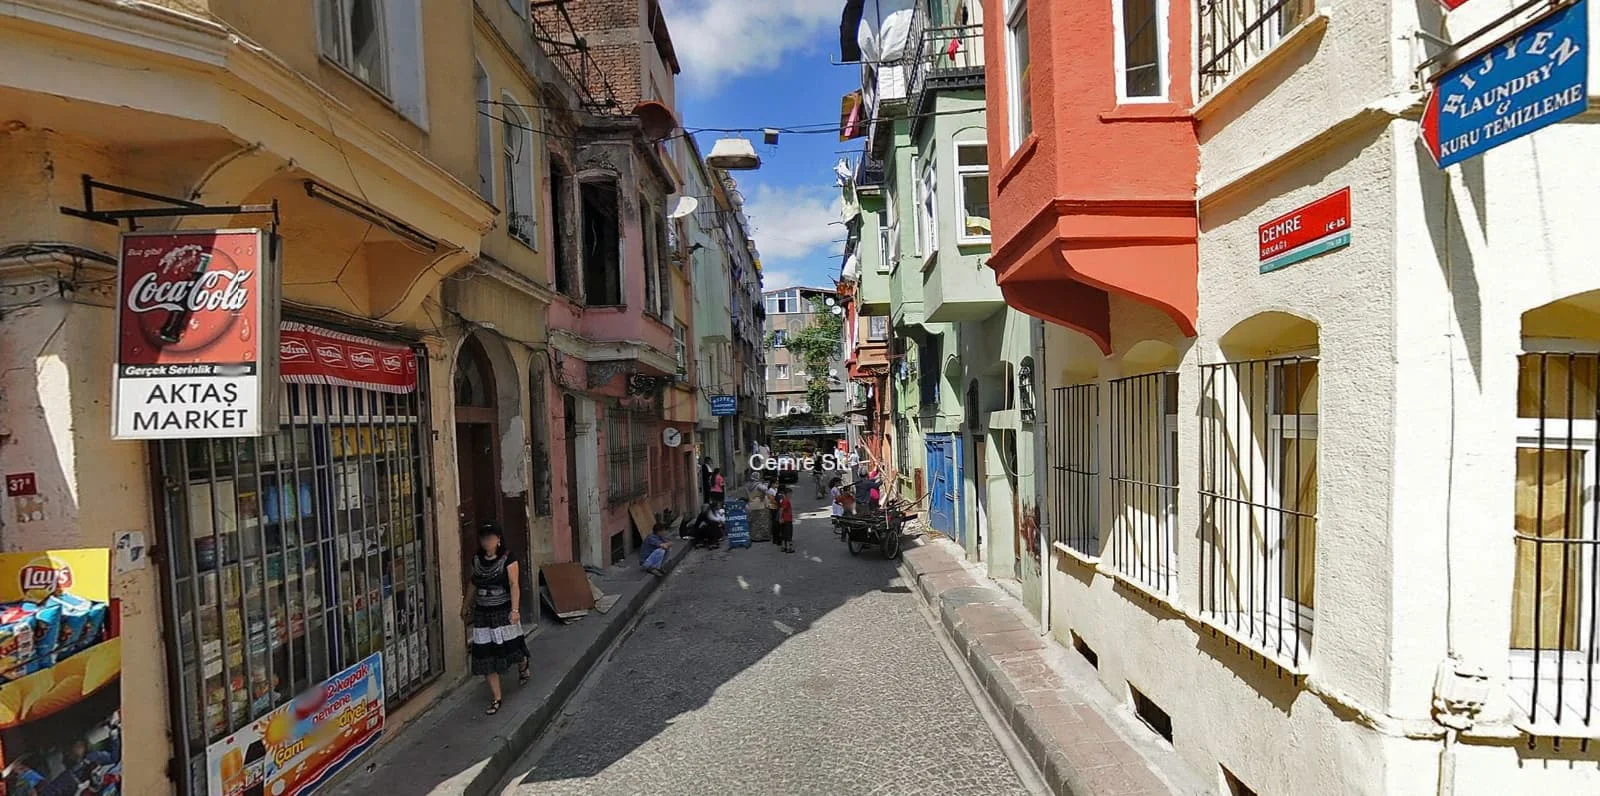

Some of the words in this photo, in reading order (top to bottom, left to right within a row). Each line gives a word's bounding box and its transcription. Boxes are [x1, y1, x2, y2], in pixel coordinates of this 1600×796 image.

[1460, 62, 1553, 119] LAUNDRY
[1496, 100, 1511, 115] &
[1440, 128, 1480, 158] KURU
[1483, 84, 1583, 140] TEMİZLEME
[1262, 215, 1302, 243] CEMRE
[128, 269, 254, 313] Coca-Cola
[125, 365, 167, 378] Gerçek
[167, 365, 211, 376] Serinlik
[146, 382, 238, 407] AKTAŞ
[133, 409, 248, 431] MARKET
